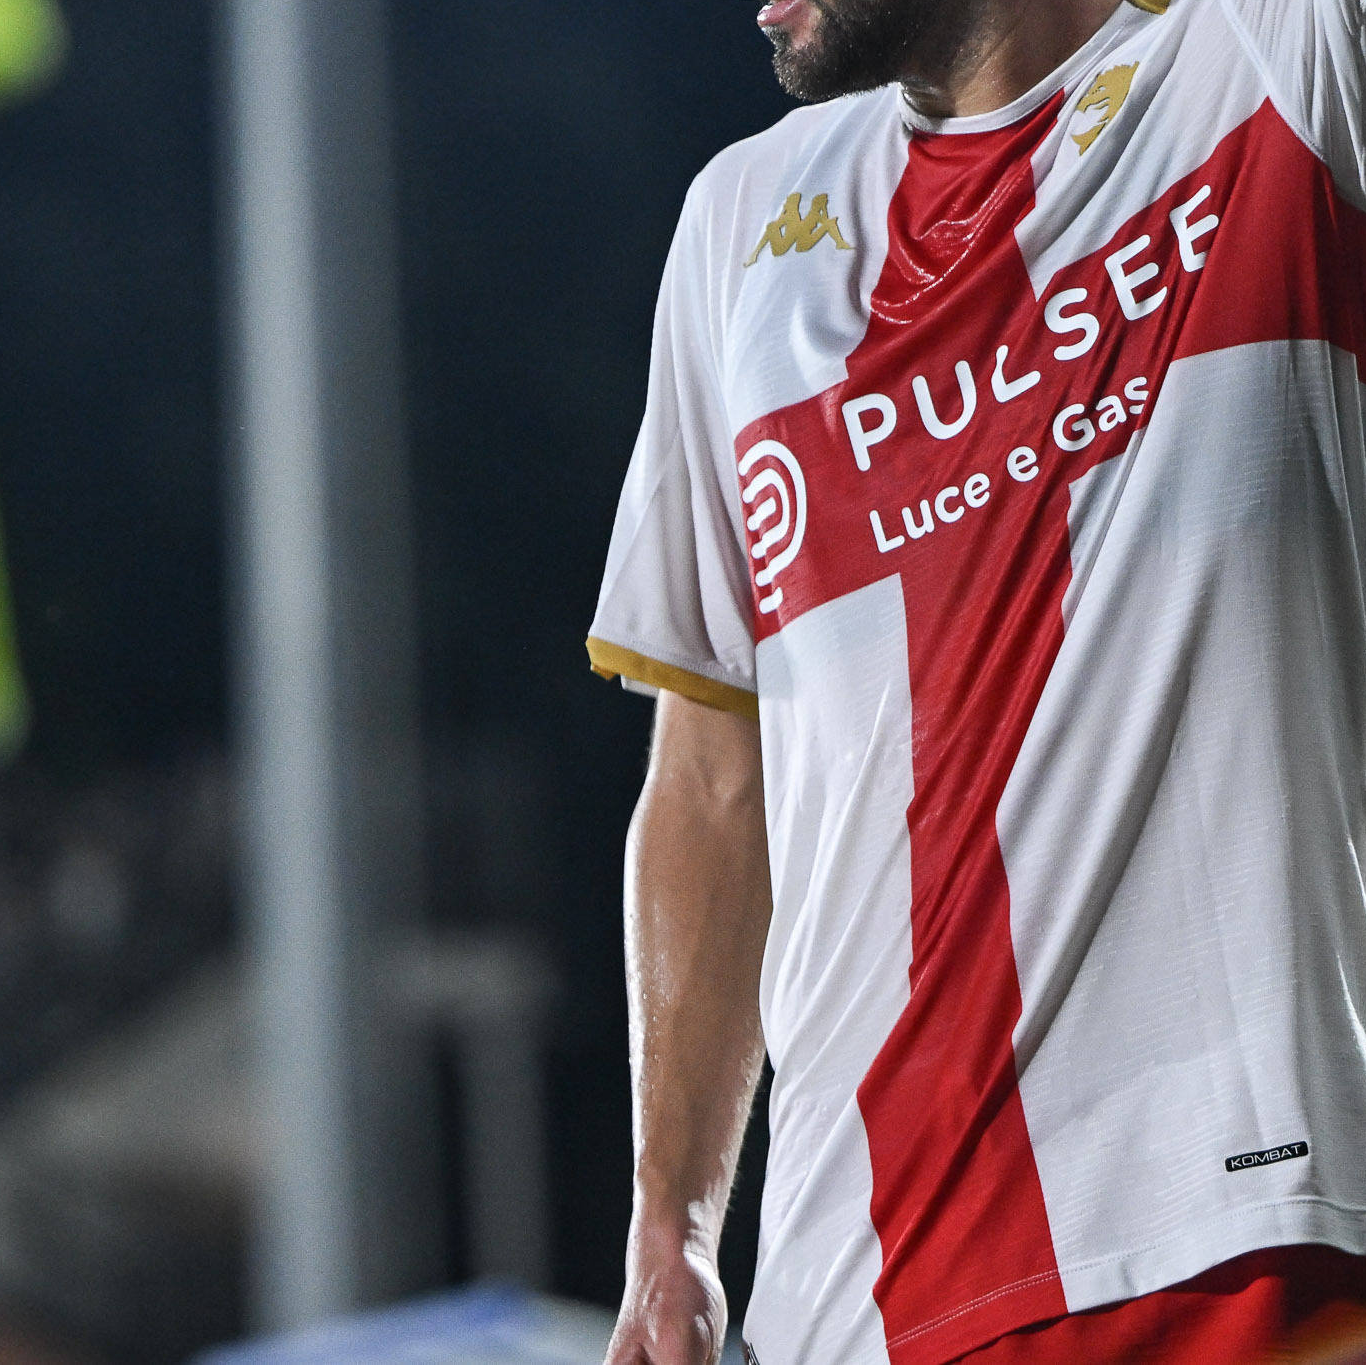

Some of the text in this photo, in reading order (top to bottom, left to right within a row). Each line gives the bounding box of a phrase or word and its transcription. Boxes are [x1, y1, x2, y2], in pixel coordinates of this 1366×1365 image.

[841, 184, 1221, 472] PULSEE
[868, 375, 1150, 554] Luce e Gas
[1230, 1144, 1301, 1169] KOMBAT
